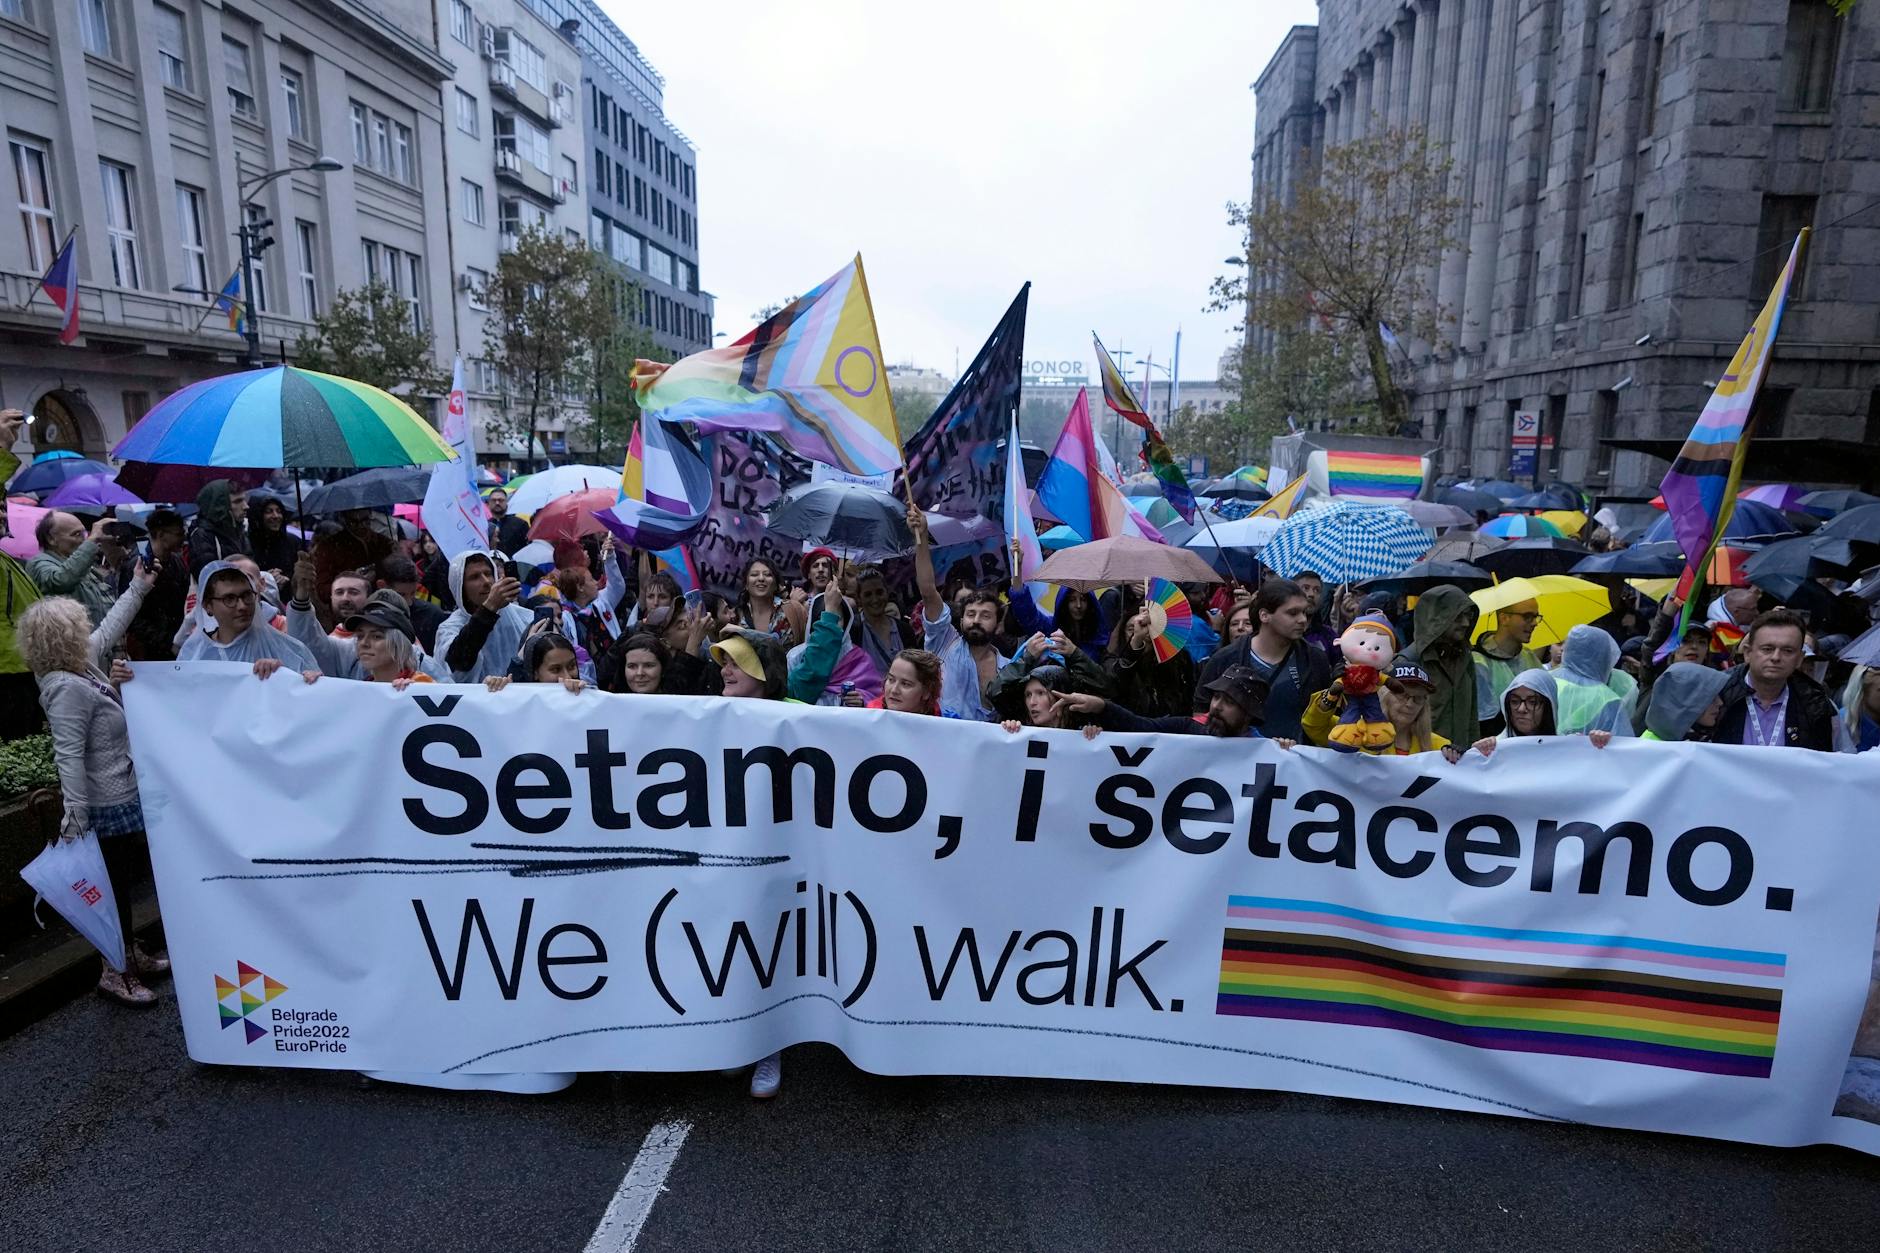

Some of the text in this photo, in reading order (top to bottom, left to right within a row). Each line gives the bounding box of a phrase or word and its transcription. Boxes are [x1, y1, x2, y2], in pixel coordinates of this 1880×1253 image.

[1021, 360, 1083, 374] HONOR
[402, 694, 1795, 912] Šetamo, i šetaćemo.
[411, 880, 1185, 1016] We (will) walk.
[271, 1008, 338, 1024] Belgrade
[273, 1025, 351, 1039] Pride2022
[275, 1039, 348, 1053] EuroPride
